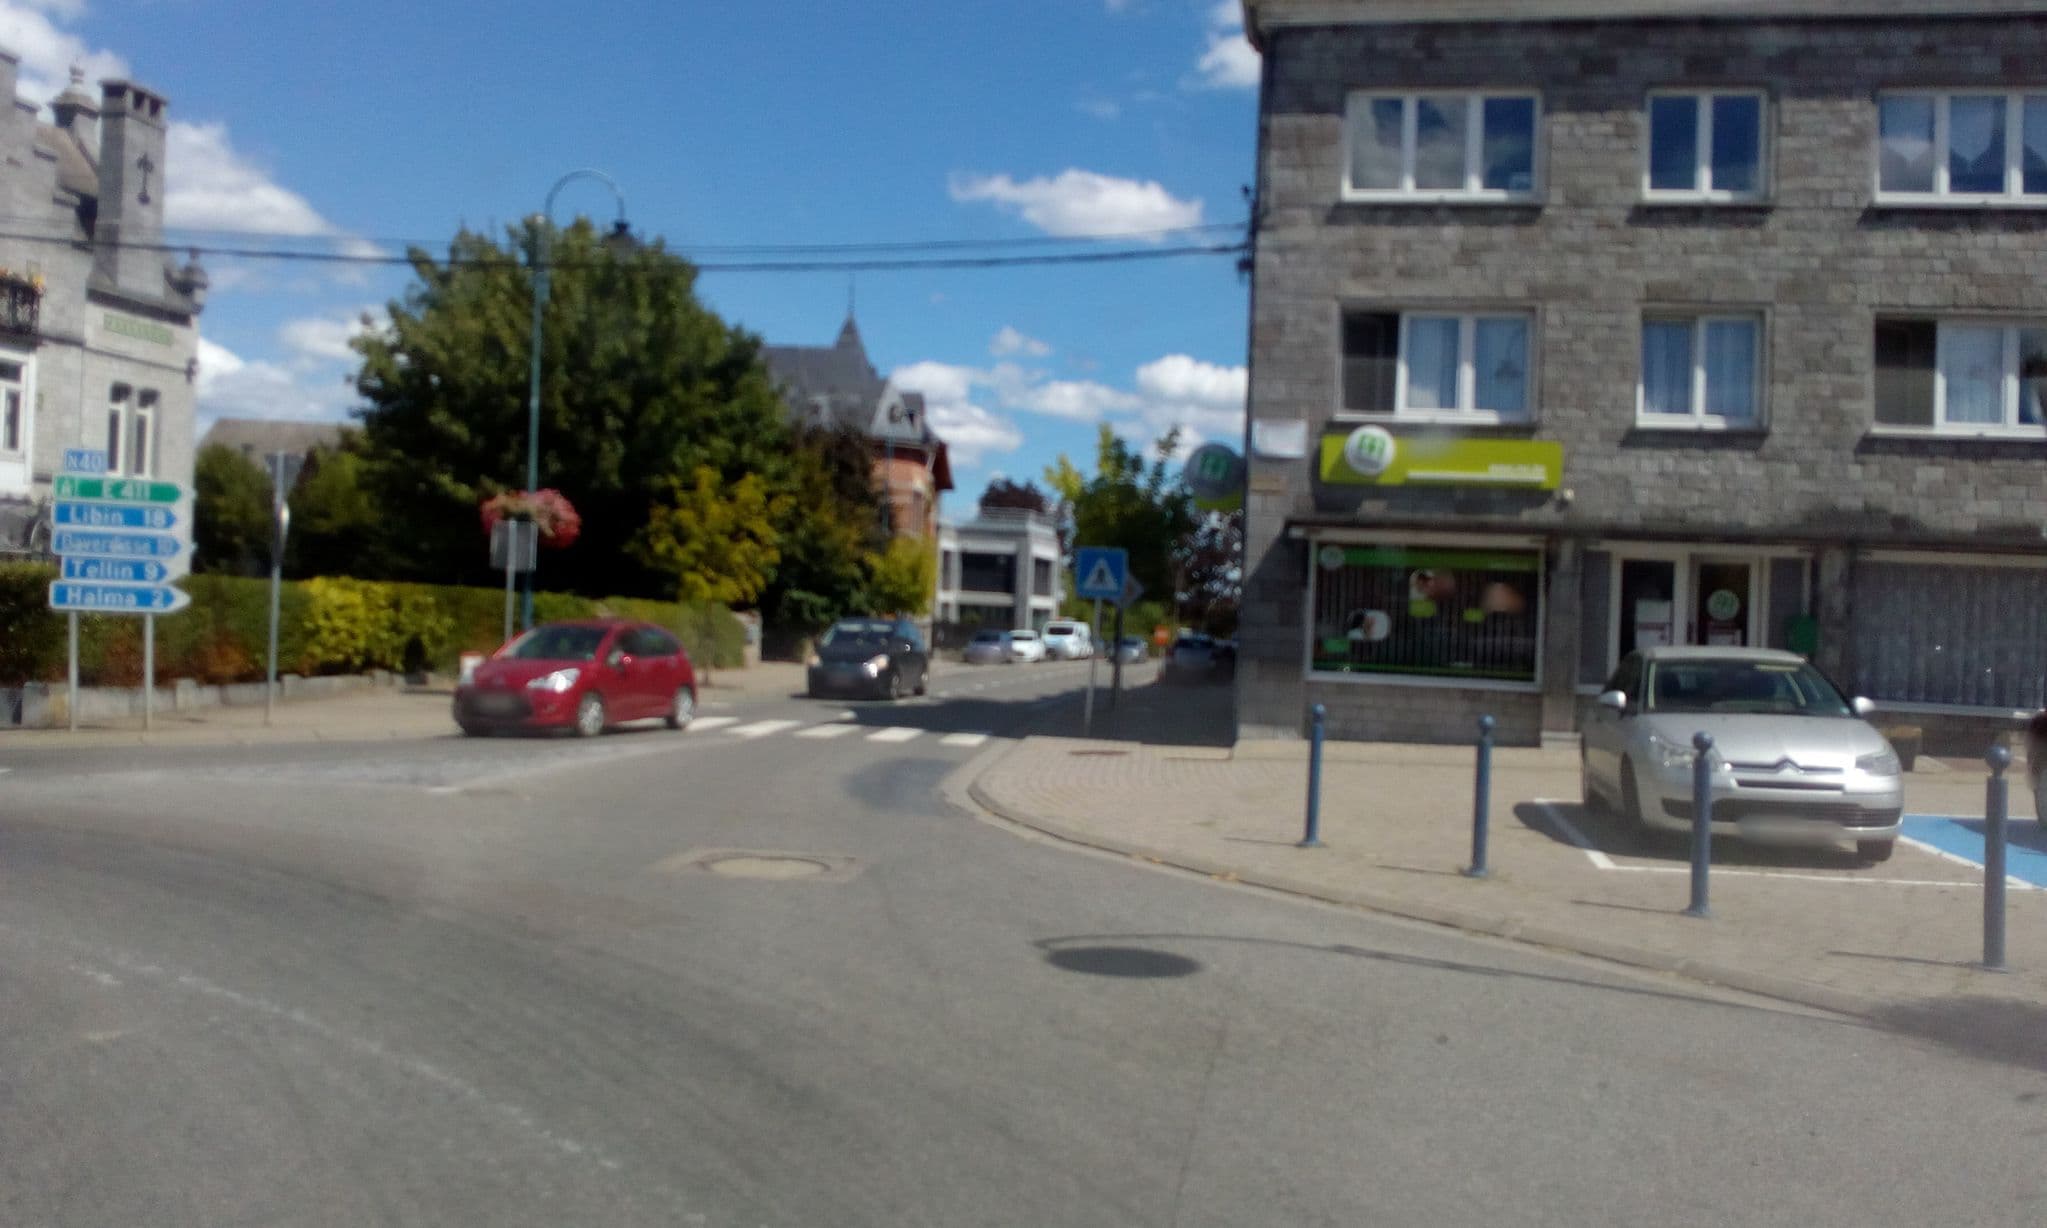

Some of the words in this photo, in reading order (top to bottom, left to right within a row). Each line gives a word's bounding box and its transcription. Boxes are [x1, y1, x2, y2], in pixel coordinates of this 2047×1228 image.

[68, 454, 101, 470] N40
[70, 505, 122, 525] Libin
[72, 559, 133, 579] Tellin
[67, 585, 137, 606] Halma
[151, 588, 163, 608] 2
